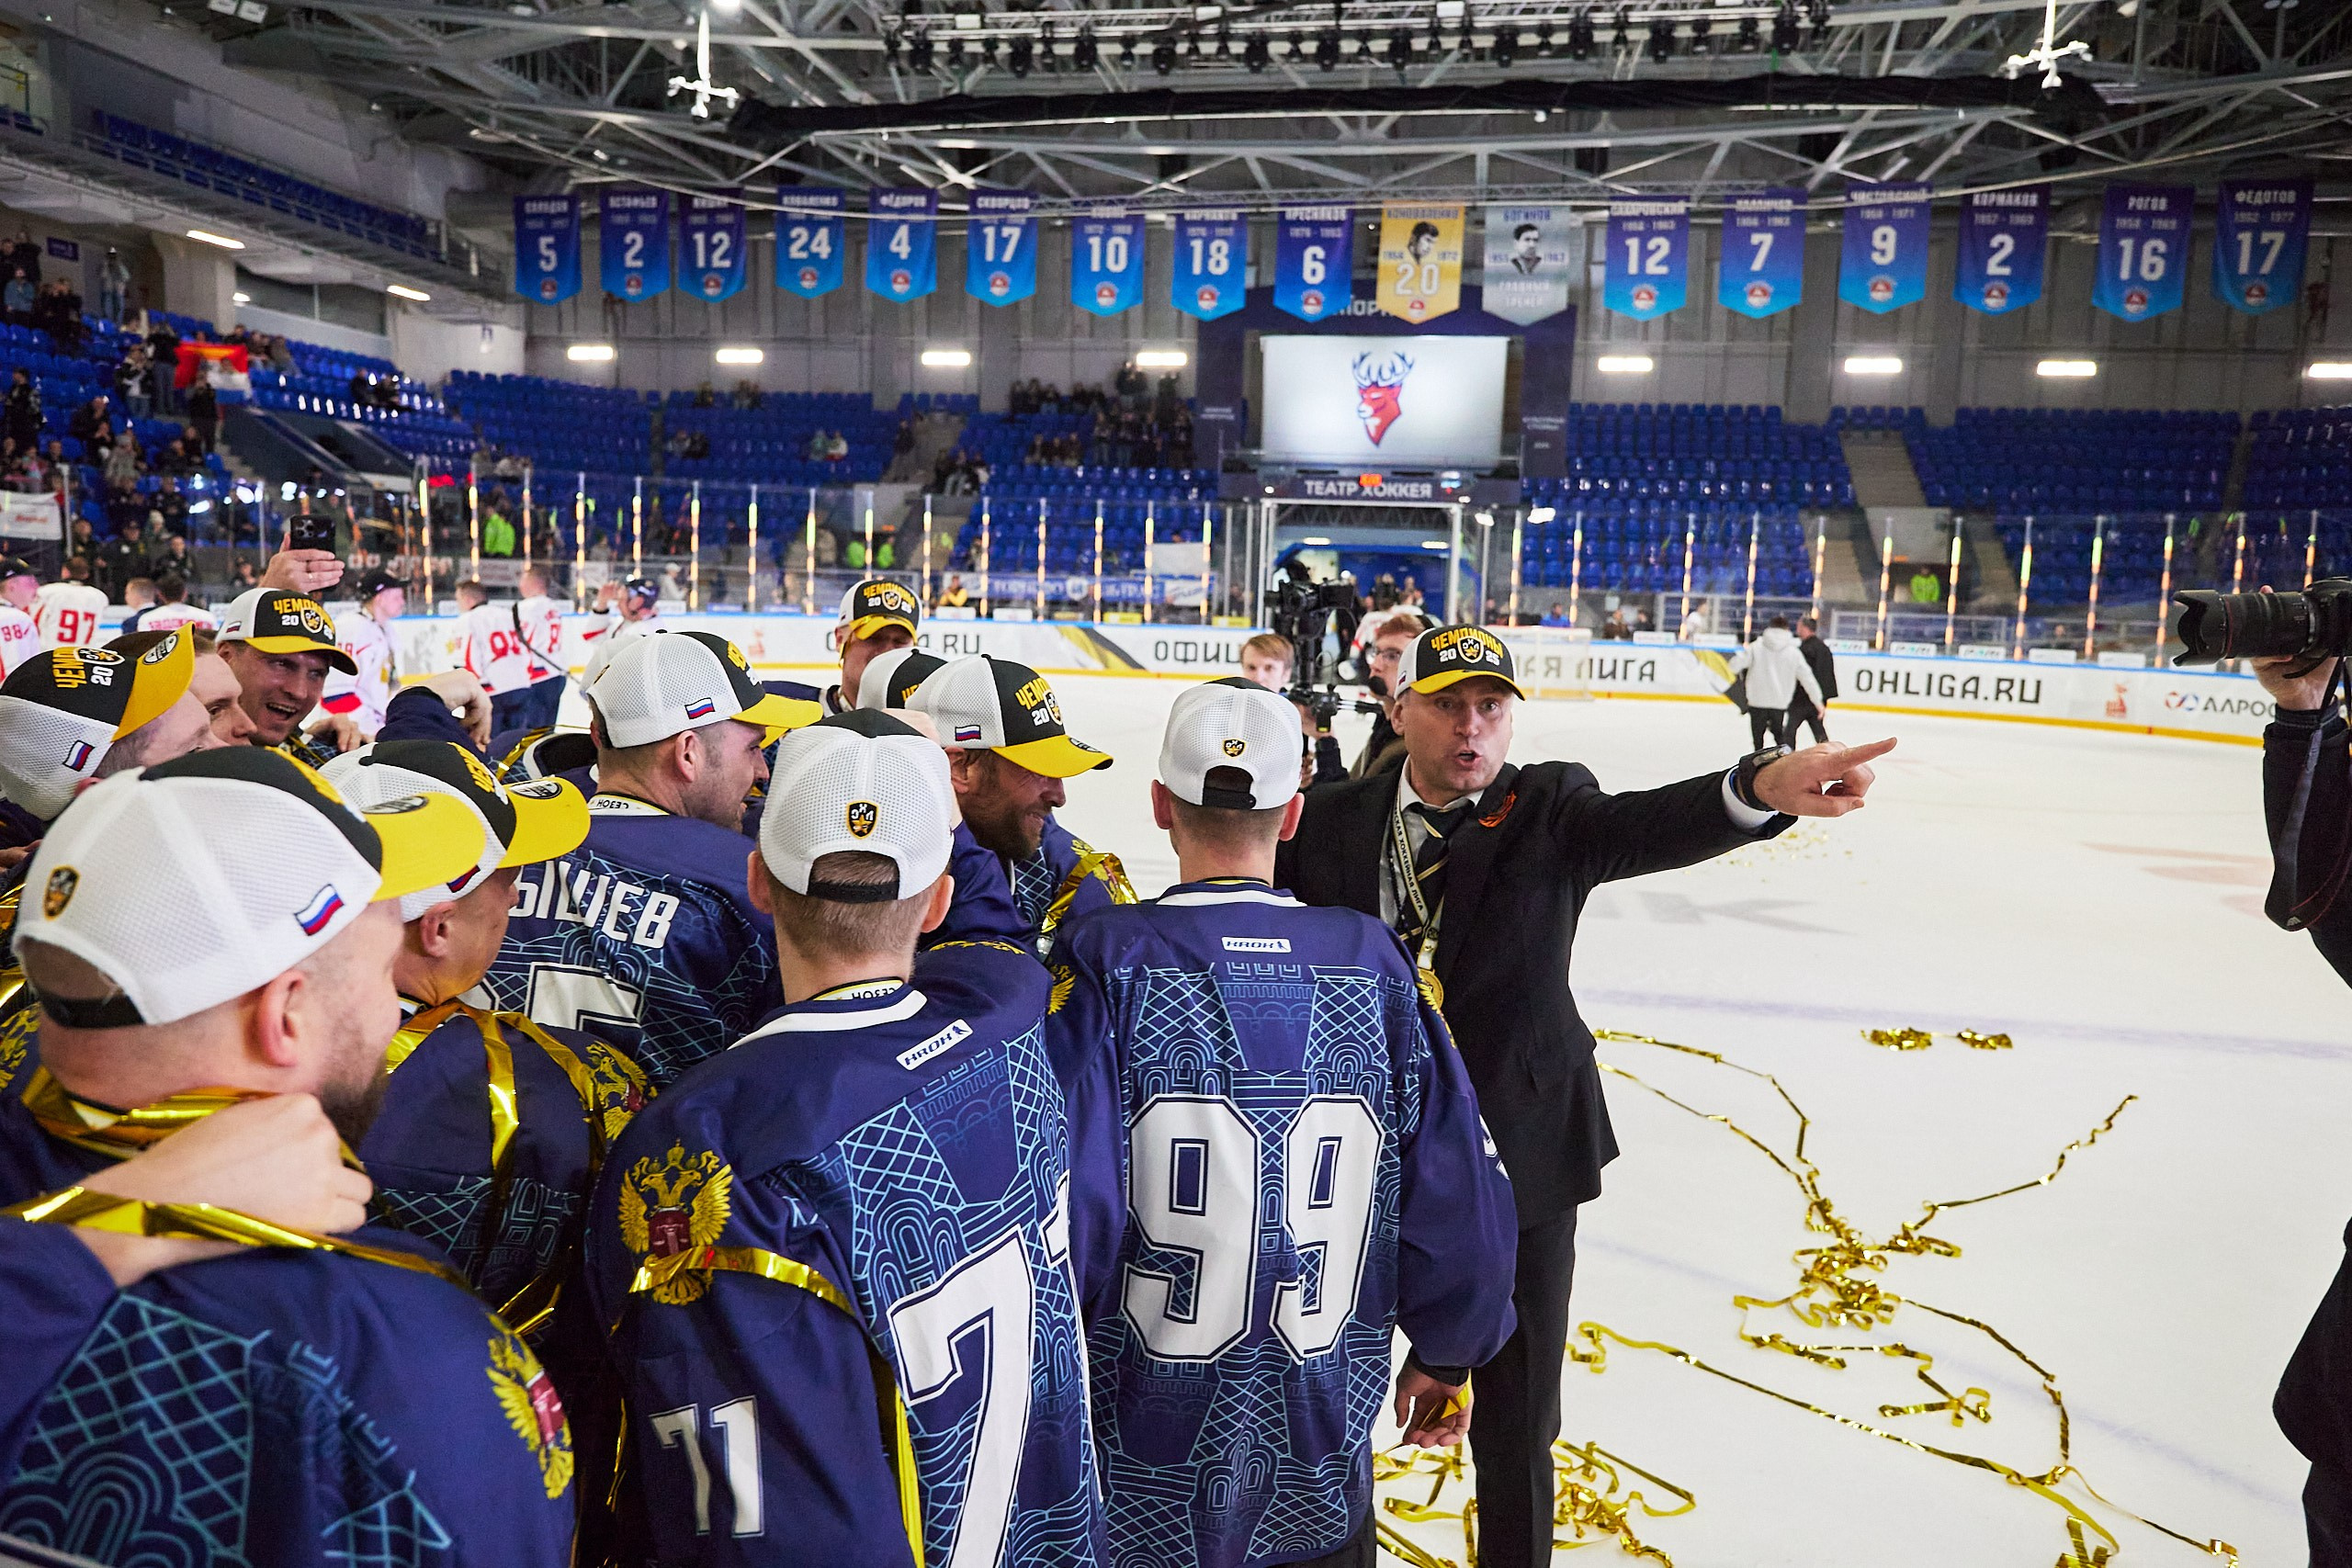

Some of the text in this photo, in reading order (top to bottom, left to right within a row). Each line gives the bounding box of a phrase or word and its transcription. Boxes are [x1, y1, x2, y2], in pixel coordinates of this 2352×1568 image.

[2128, 195, 2168, 211] РОГОВ
[2235, 189, 2296, 205] ФЕДОТОВ
[538, 236, 558, 272] 5
[624, 231, 644, 268] 2
[693, 231, 731, 268] 12
[788, 226, 831, 260] 24
[888, 224, 911, 260] 4
[983, 226, 1022, 263] 17
[1088, 236, 1128, 273] 10
[1190, 239, 1230, 276] 18
[1624, 236, 1671, 276] 12
[1749, 232, 1774, 272] 7
[1871, 225, 1898, 265] 9
[1986, 233, 2015, 276] 2
[2118, 238, 2168, 282] 16
[2236, 231, 2286, 276] 17
[1302, 245, 1326, 285] 6
[1395, 263, 1440, 296] 20
[1305, 479, 1432, 498] ТЕАТР ХОККЕЯ
[57, 609, 96, 646] 97
[281, 615, 300, 626] 20
[1430, 627, 1504, 659] ЧЕМПИОНЫ
[1439, 648, 1500, 666] 20 25
[91, 666, 114, 686] 20
[1576, 657, 1656, 681] ЛИГА
[1856, 669, 2041, 705] OHLIGA.RU
[1031, 709, 1050, 727] 20
[1399, 839, 1415, 888] ХОККЕЙНАЯ
[1411, 888, 1424, 911] ЛИГА
[1120, 1093, 1385, 1365] 99
[649, 1395, 766, 1539] 71
